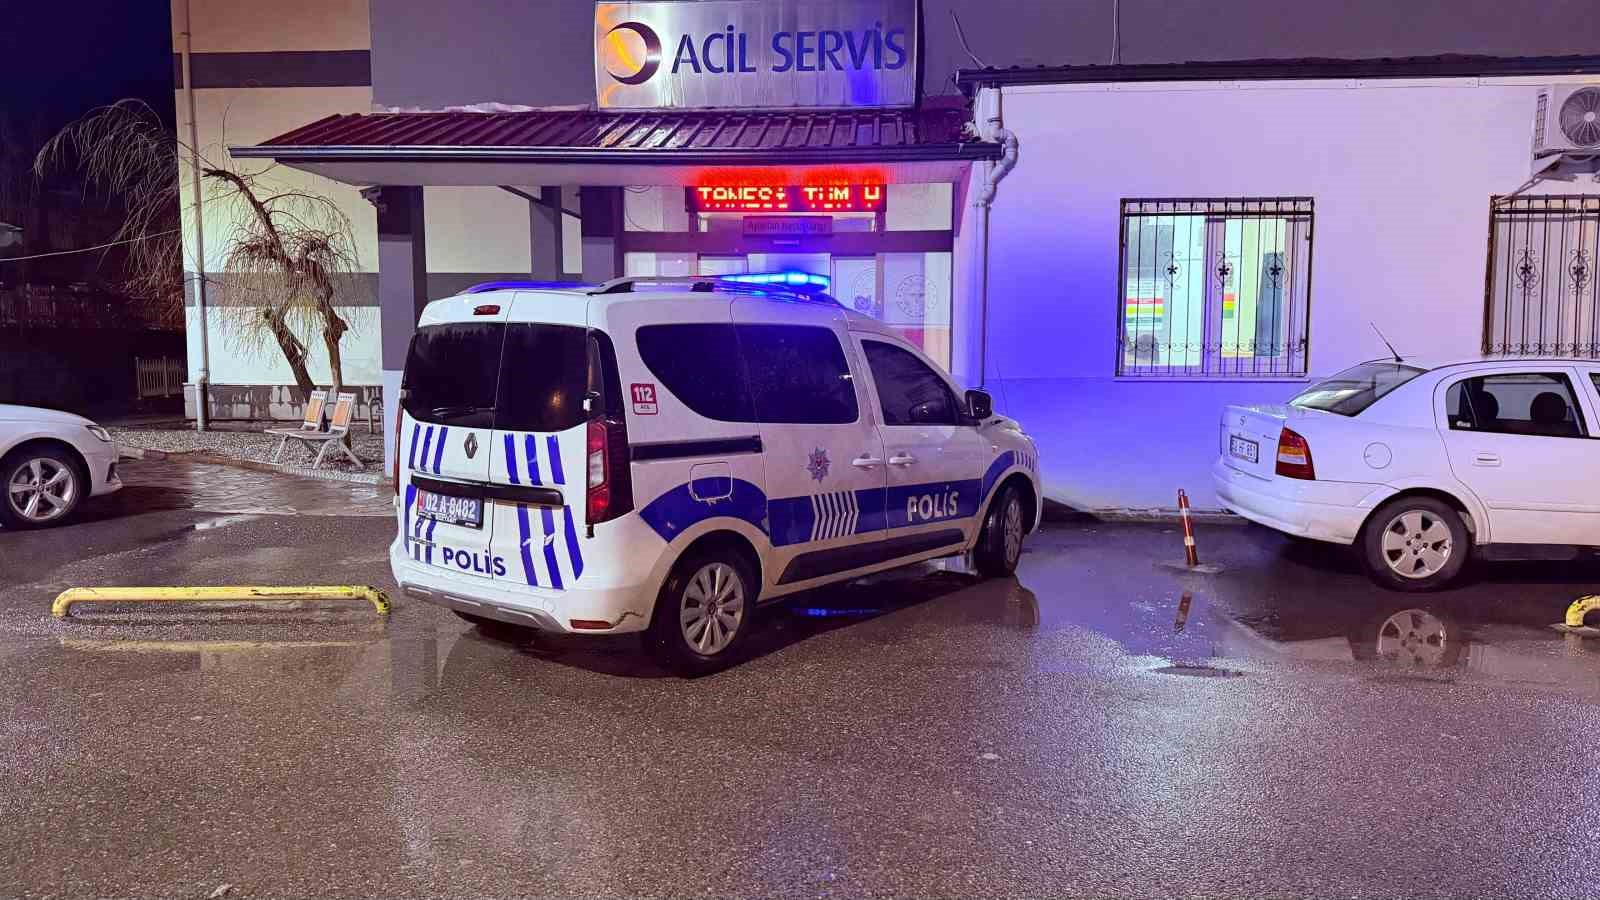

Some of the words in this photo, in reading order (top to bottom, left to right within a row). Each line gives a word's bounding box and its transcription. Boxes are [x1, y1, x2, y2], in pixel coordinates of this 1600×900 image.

[671, 25, 756, 74] ACİL
[772, 22, 906, 72] SERVİS
[633, 386, 654, 402] 112
[426, 494, 438, 510] 02
[907, 485, 959, 522] POLİS
[442, 547, 506, 576] POLİS
